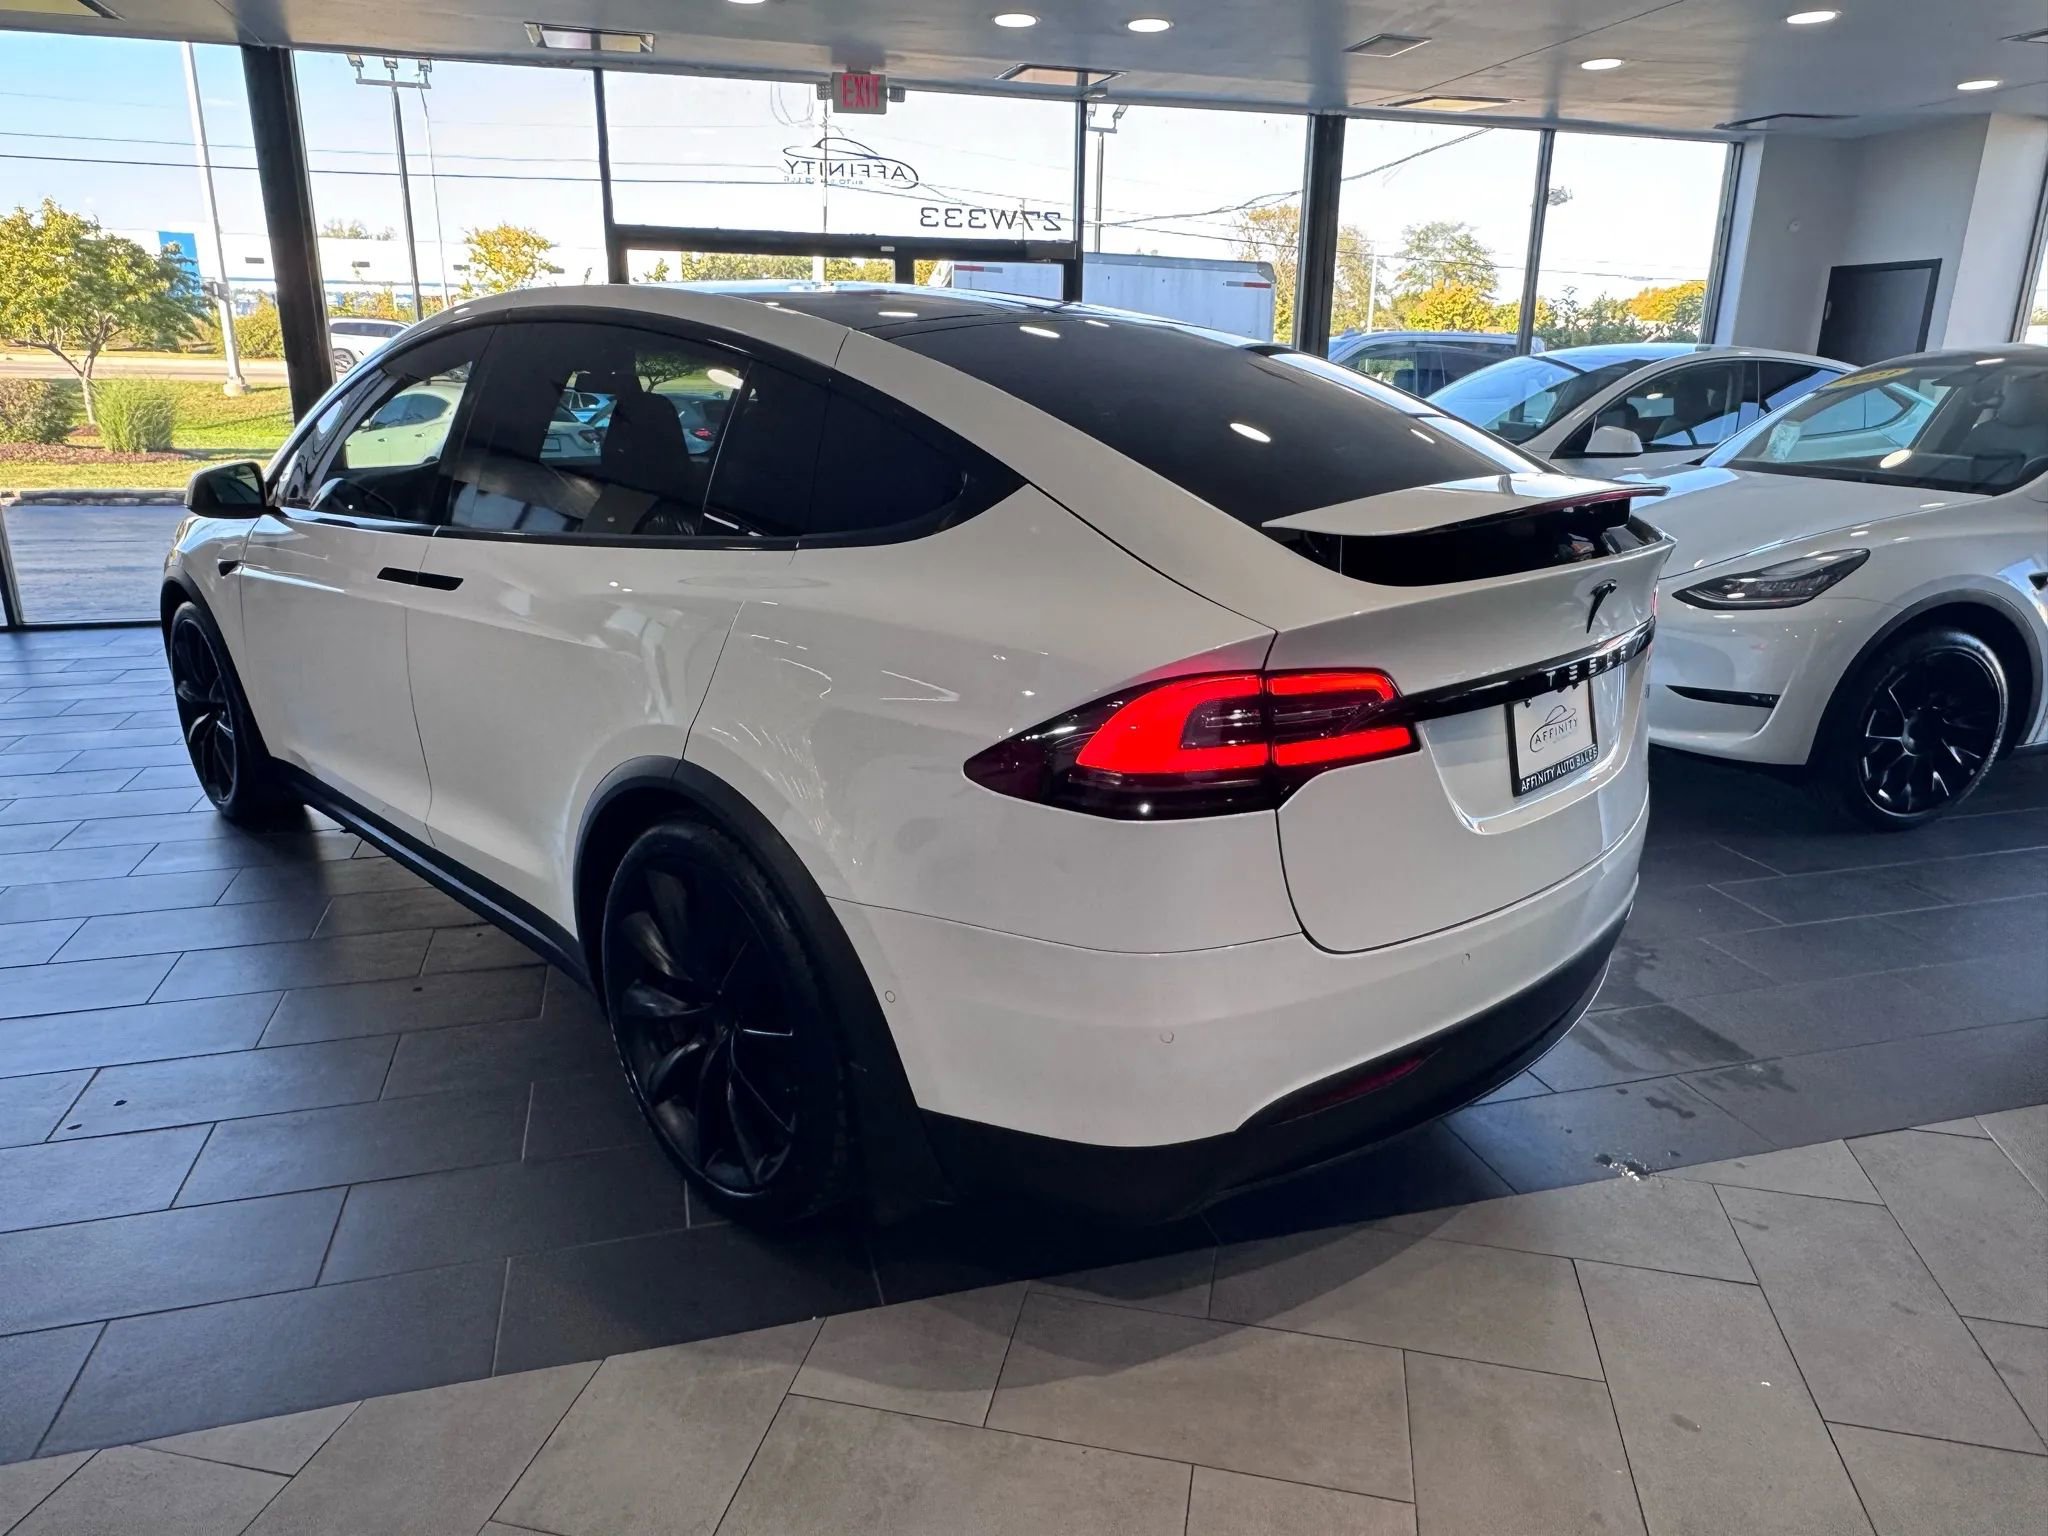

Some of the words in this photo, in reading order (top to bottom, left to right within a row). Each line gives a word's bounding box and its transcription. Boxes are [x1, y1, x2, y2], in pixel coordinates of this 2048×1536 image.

[842, 74, 880, 109] EXIT
[1546, 645, 1627, 688] TESLA
[1534, 718, 1578, 745] AFFINITY
[1521, 766, 1555, 792] AFFINITY
[1556, 758, 1576, 776] AUTO
[1576, 746, 1598, 767] SALES
